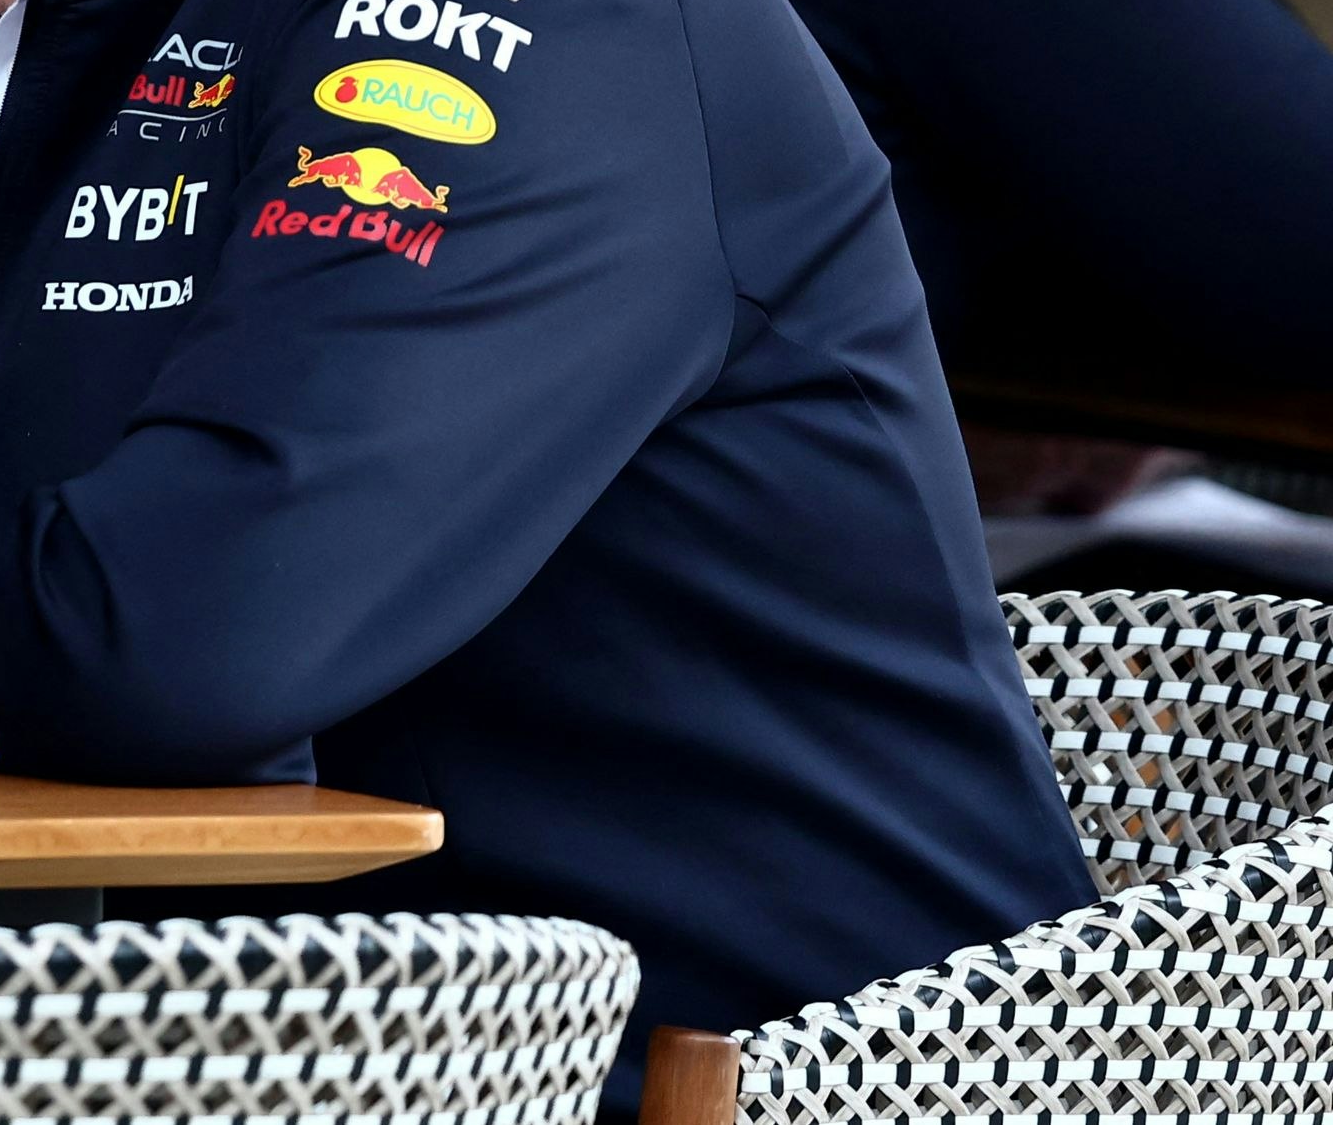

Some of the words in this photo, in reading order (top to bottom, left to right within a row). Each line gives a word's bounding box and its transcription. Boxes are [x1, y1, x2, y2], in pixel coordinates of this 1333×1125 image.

[147, 33, 244, 72] ACL
[360, 76, 477, 132] RAUCH
[106, 116, 226, 143] ACIN
[64, 174, 209, 242] BYBIT
[250, 198, 354, 239] Red
[347, 209, 446, 269] Bull
[41, 275, 194, 313] HONDA
